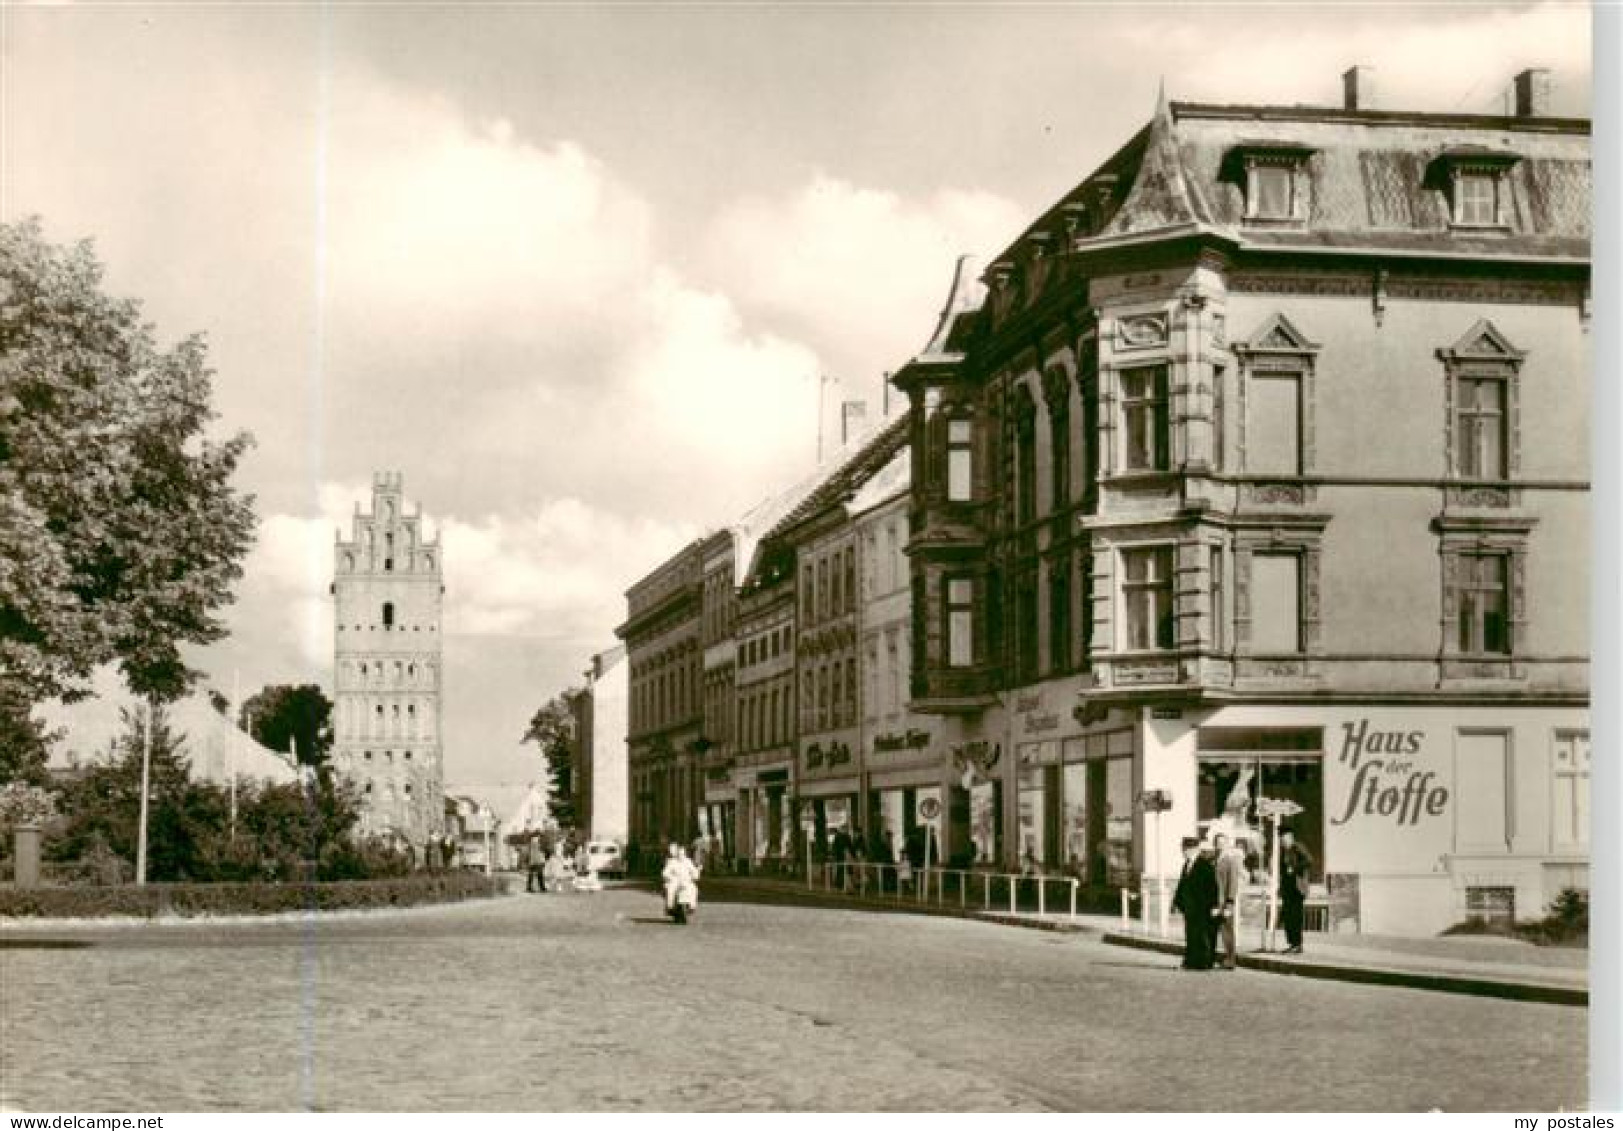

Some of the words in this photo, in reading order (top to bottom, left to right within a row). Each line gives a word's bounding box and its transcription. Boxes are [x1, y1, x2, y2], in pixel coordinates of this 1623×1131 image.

[1339, 719, 1424, 769] Haus
[1386, 758, 1413, 774] der
[1330, 760, 1449, 825] Stoffe
